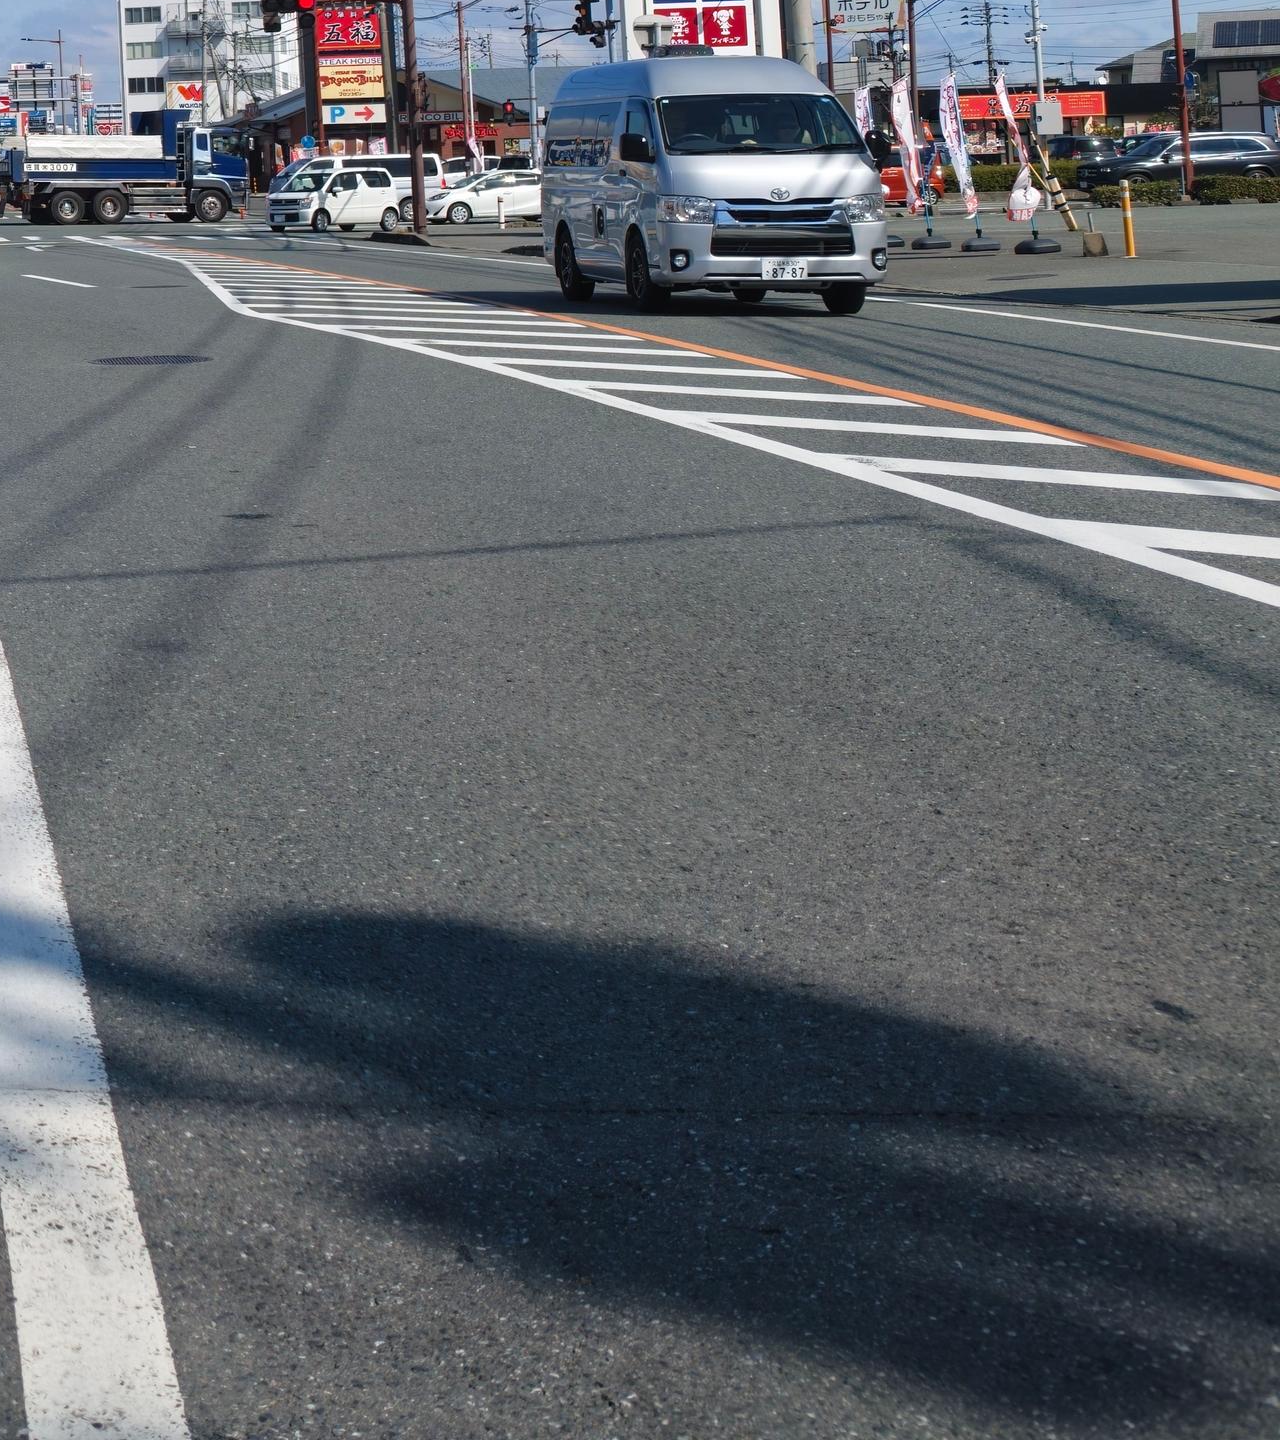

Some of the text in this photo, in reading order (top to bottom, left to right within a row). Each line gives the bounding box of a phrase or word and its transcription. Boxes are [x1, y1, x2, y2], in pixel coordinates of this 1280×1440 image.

[320, 20, 377, 45] 五福
[330, 106, 345, 123] P
[771, 267, 805, 279] 87-87
